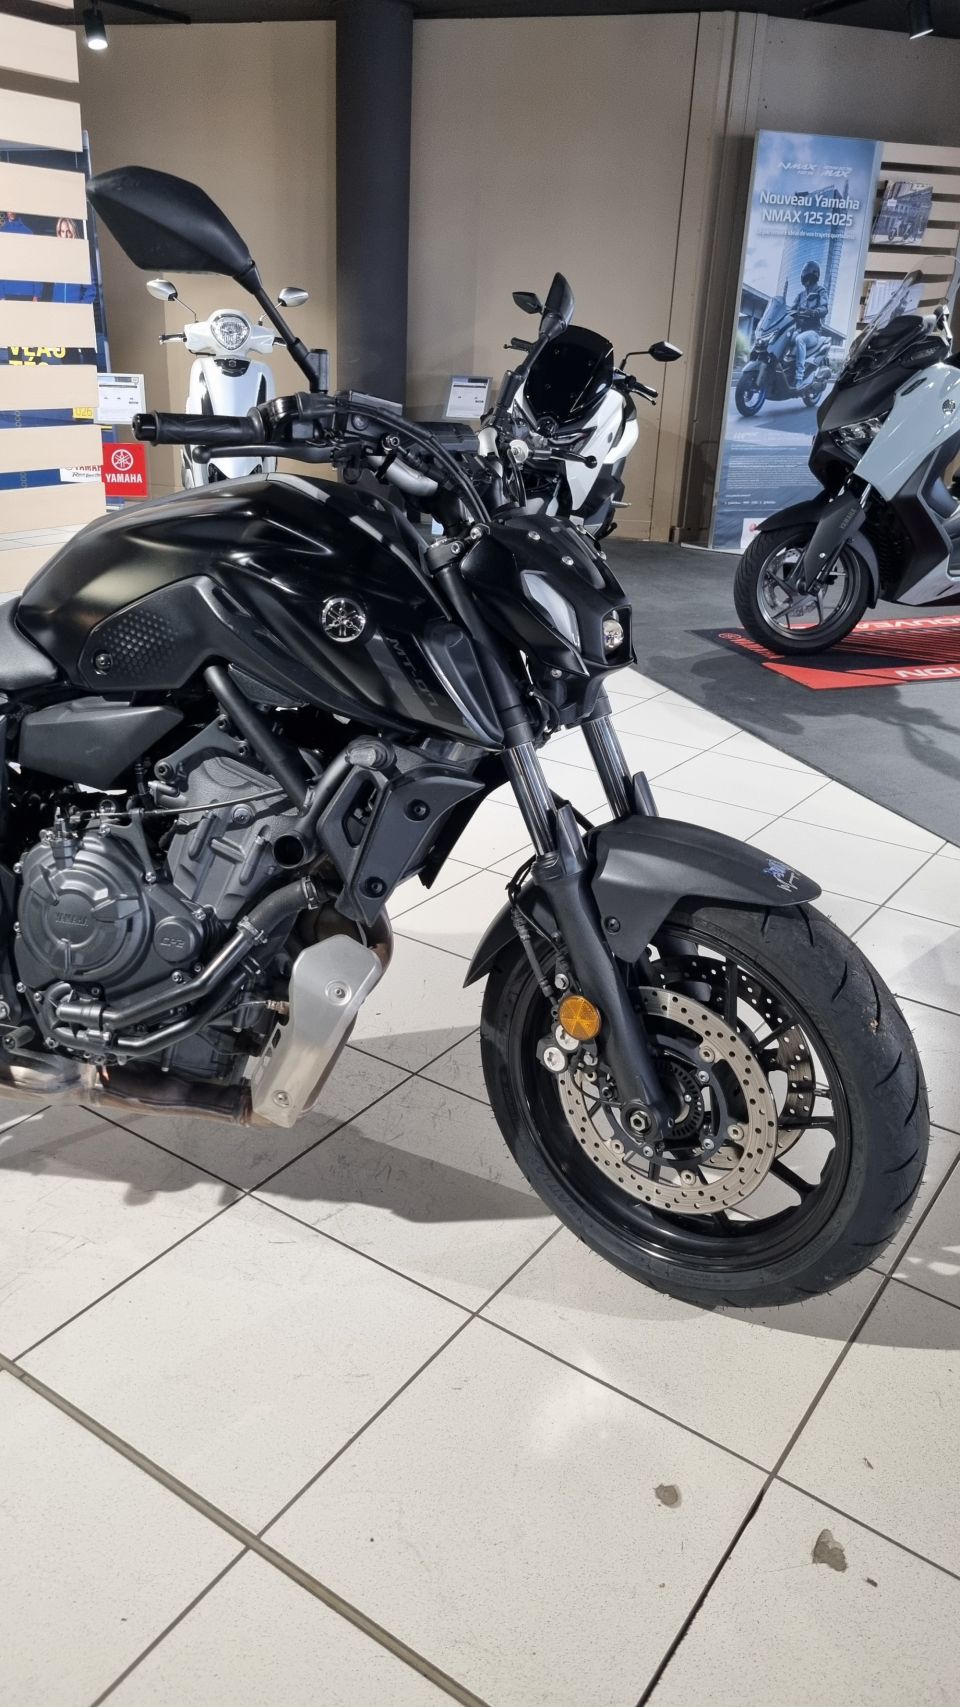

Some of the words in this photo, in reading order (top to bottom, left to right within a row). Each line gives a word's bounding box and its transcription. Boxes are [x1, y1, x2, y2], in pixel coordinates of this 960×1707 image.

[759, 191, 812, 206] Nouveau
[815, 193, 860, 210] Yamaha
[762, 208, 802, 223] NMAX
[803, 211, 824, 225] 125
[825, 212, 853, 226] 2025
[105, 473, 143, 483] YAMAHA
[384, 636, 439, 707] MT-07
